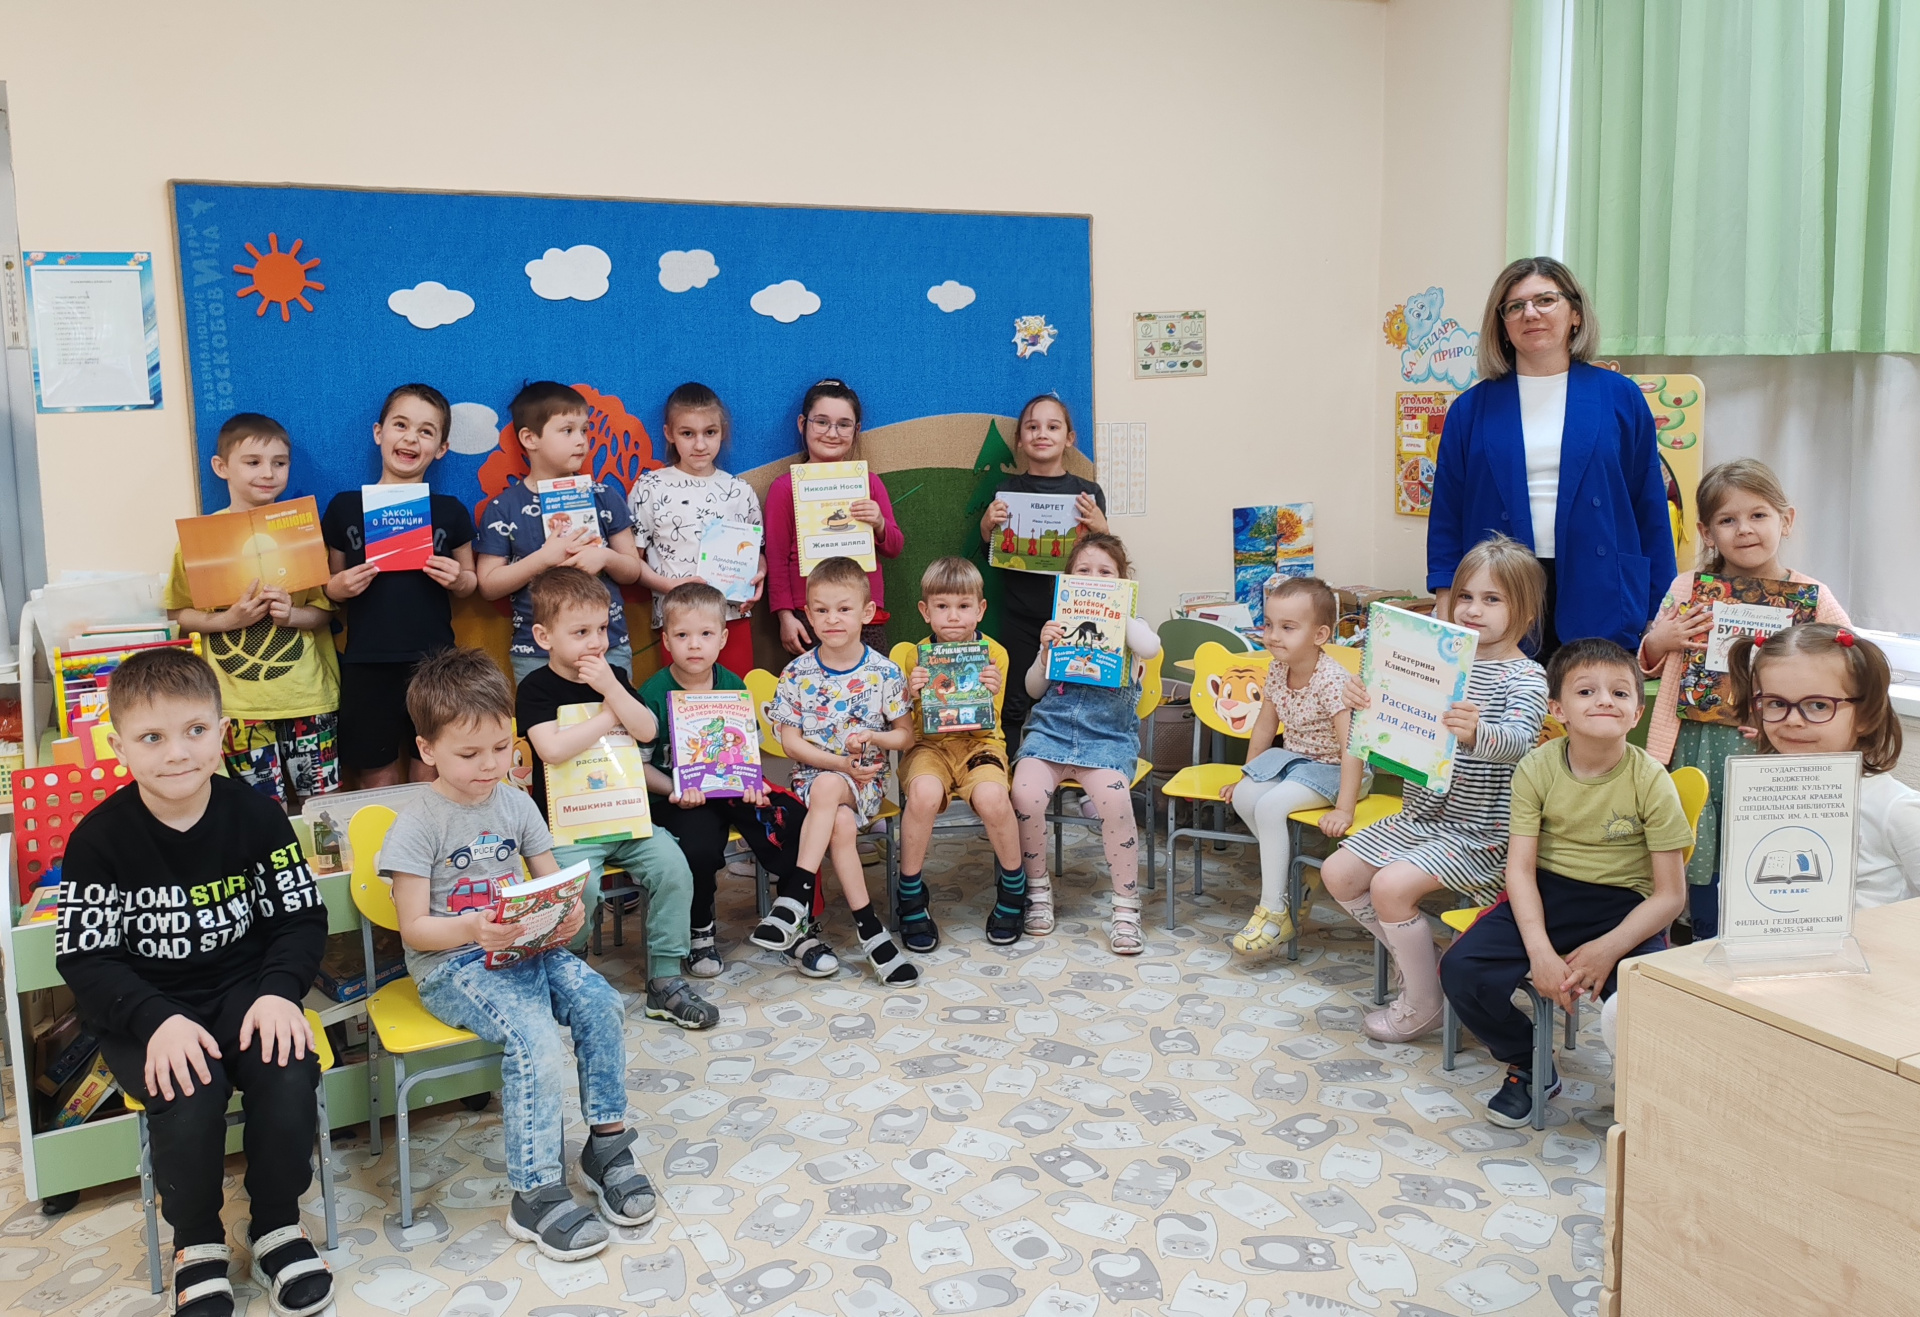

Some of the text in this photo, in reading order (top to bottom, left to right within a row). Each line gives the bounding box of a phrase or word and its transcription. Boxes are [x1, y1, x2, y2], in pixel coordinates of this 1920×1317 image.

[1404, 320, 1458, 378] КАЛЕНДАРЬ
[1400, 396, 1434, 405] УГОЛОК
[1404, 405, 1446, 415] ПРИРОДЫ
[1031, 502, 1065, 511] КВАРТЕТ
[382, 509, 413, 517] ЗАКОН
[382, 517, 423, 526] ПОЛИЦИИ
[1073, 599, 1104, 609] Котёнок
[1103, 607, 1121, 620] Гав
[1719, 618, 1782, 629] ПРИКЛЮЧЕНИЯ
[1392, 651, 1436, 672] Екатерина
[1384, 660, 1440, 686] Климонтович
[677, 703, 750, 714] Сказки-малютки
[696, 709, 723, 717] первого
[1381, 693, 1437, 723] Рассказы
[1376, 711, 1436, 741] для детей
[576, 757, 612, 767] расска
[1760, 766, 1832, 774] ГОСУДАРСТВЕННОЕ
[1772, 775, 1820, 783] БЮДЖЕТНОЕ
[563, 797, 642, 813] Мишкина каша
[1739, 802, 1845, 812] СПЕЦИАЛЬНАЯ БИБЛИОТЕКА
[1734, 915, 1843, 926] ФИЛИАЛ ГЕЛЕНДЖИКСКИЙ
